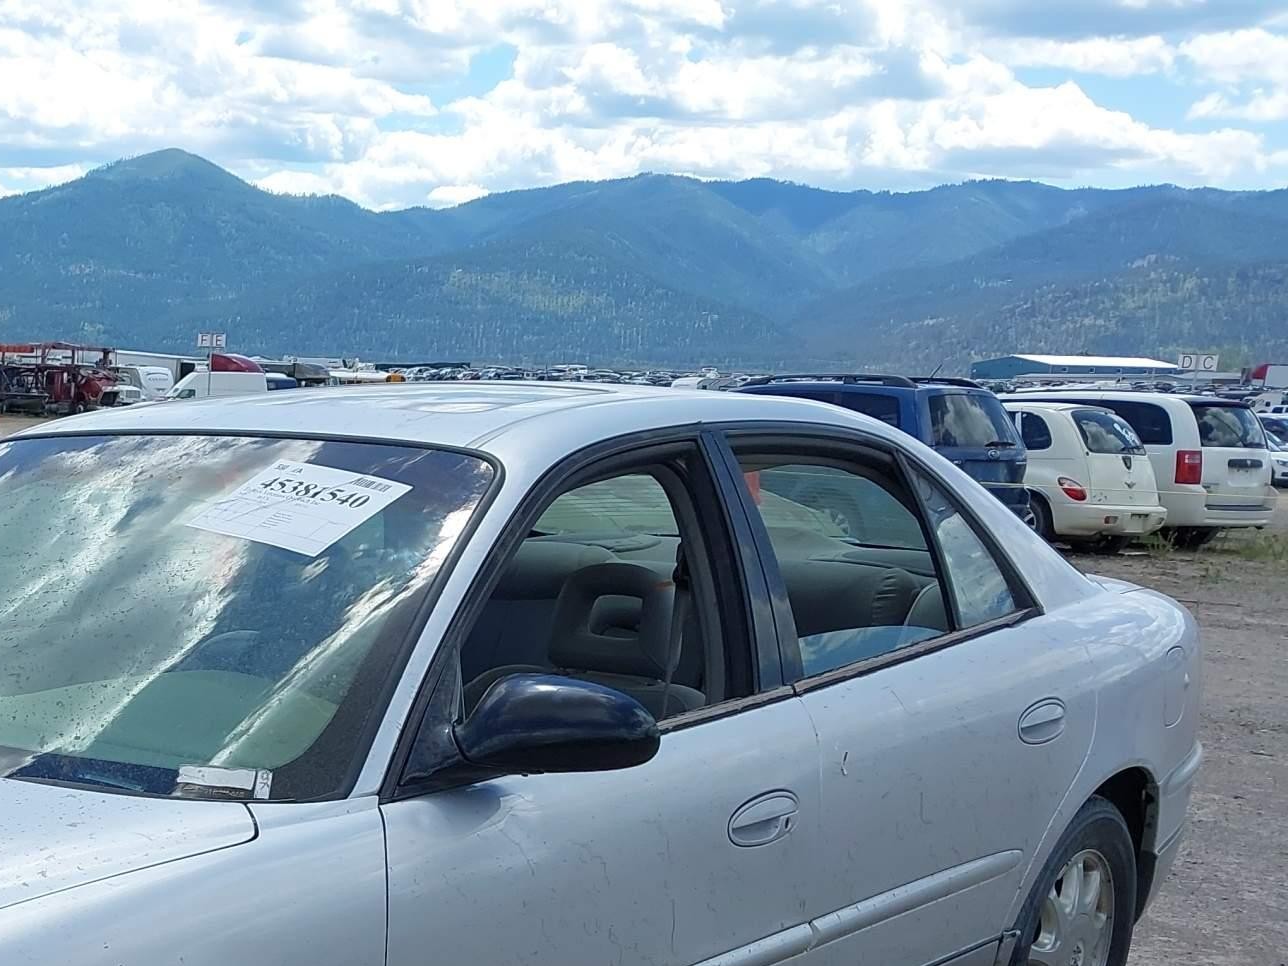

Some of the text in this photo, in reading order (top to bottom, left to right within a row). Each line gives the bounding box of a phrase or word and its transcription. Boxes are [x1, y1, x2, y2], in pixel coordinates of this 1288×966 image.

[200, 335, 223, 347] F E
[1181, 356, 1214, 370] D C
[259, 476, 371, 509] 45381540
